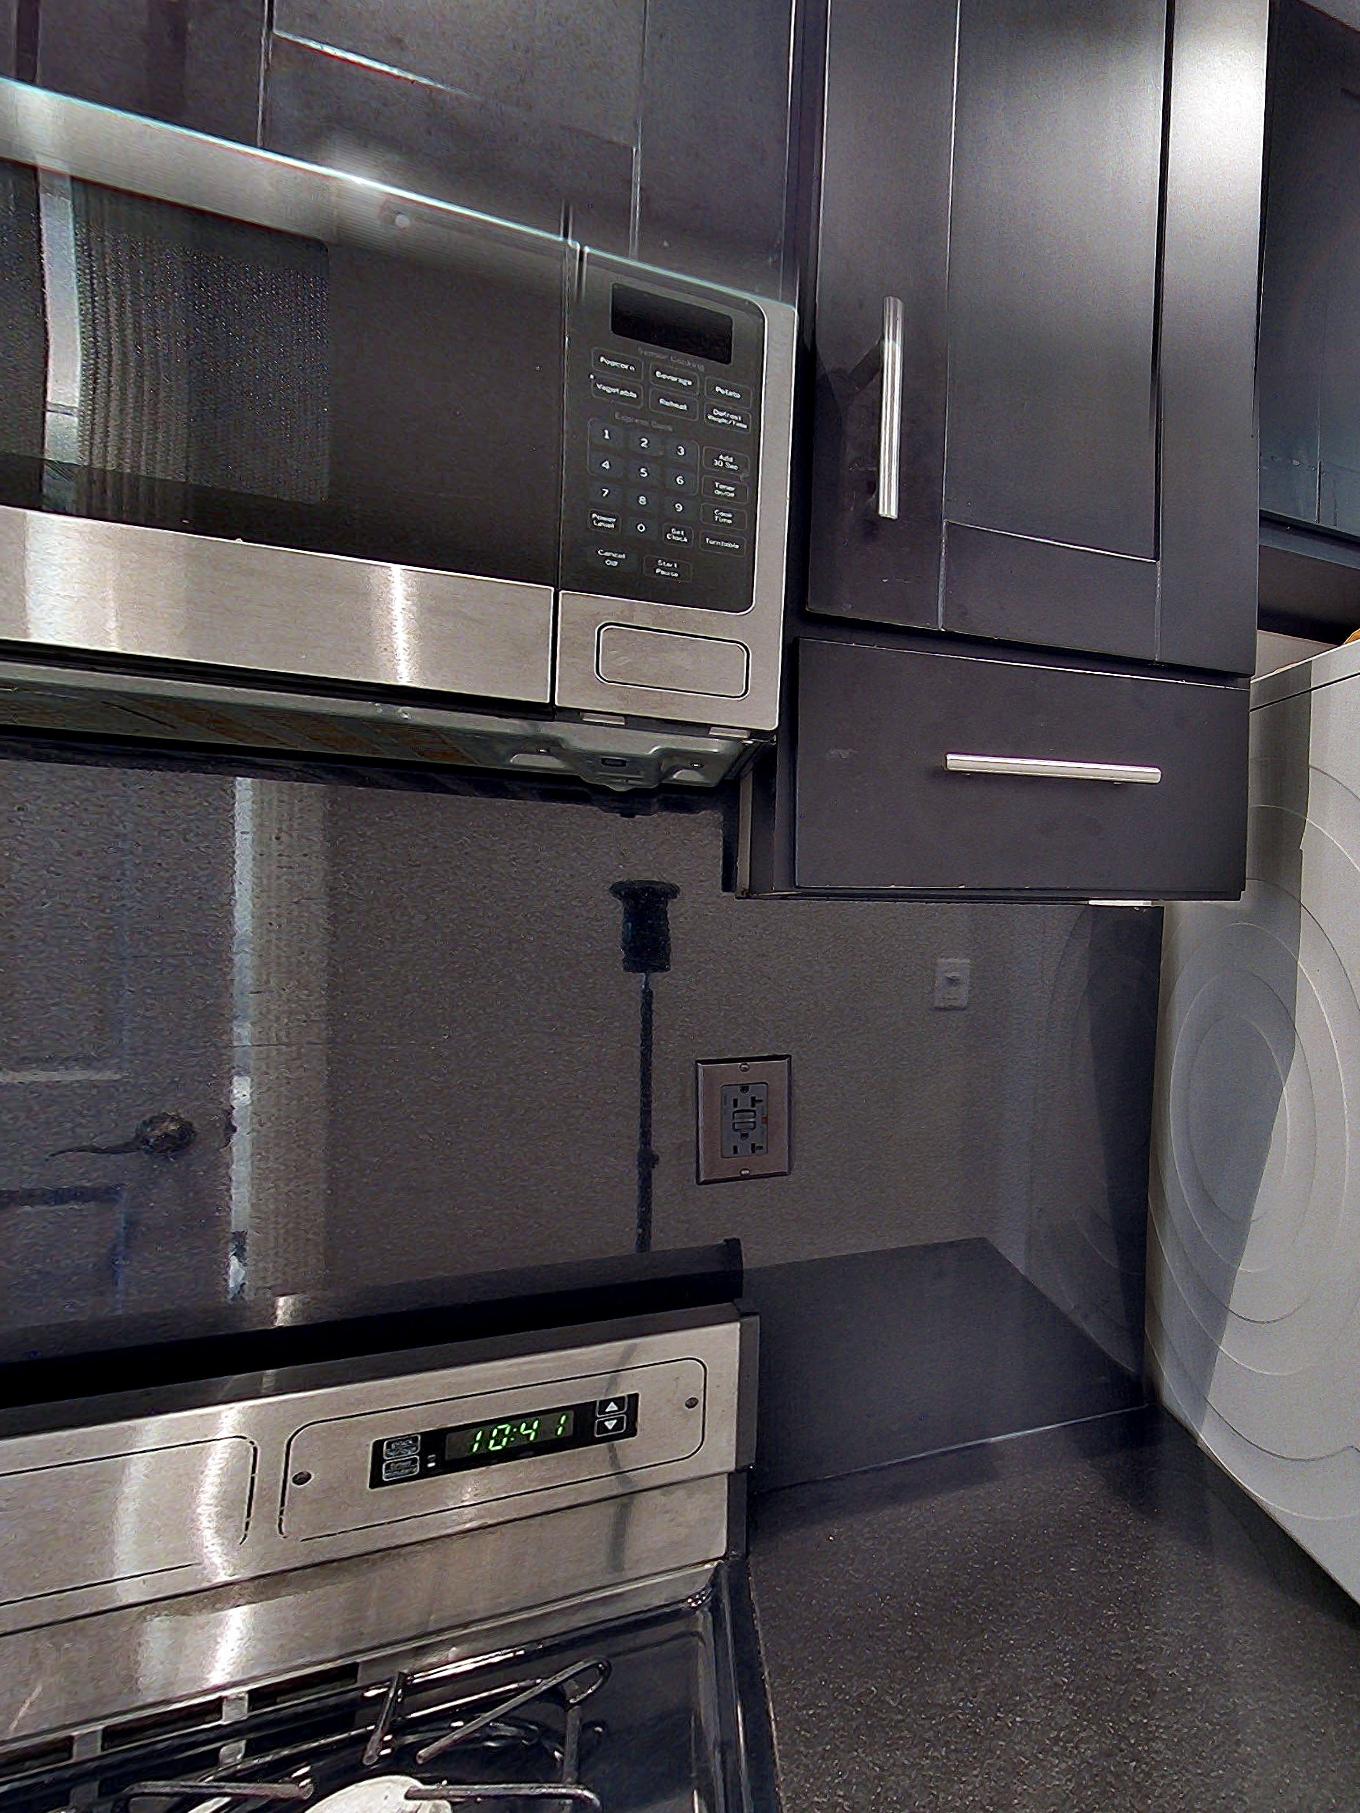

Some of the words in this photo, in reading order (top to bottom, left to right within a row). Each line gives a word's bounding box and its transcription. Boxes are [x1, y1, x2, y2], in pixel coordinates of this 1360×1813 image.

[600, 356, 635, 371] Popcorn
[655, 370, 693, 387] Beverage
[596, 383, 637, 398] Vegetable
[715, 386, 741, 399] Potato
[603, 429, 610, 440] 1
[640, 437, 649, 448] 2
[677, 445, 685, 456] 3
[713, 459, 723, 468] 30
[718, 454, 734, 463] Add
[601, 460, 610, 470] 4
[639, 468, 648, 478] 5
[676, 475, 684, 485] 6
[601, 488, 609, 498] 7
[638, 495, 647, 506] 8
[674, 503, 683, 513] 9
[637, 523, 646, 533] 0
[666, 533, 688, 543] Clock
[705, 537, 740, 549] Turntable
[598, 549, 626, 559] Cancel
[657, 559, 678, 569] Start
[655, 568, 679, 578] Pause
[471, 1413, 568, 1453] 10:41
